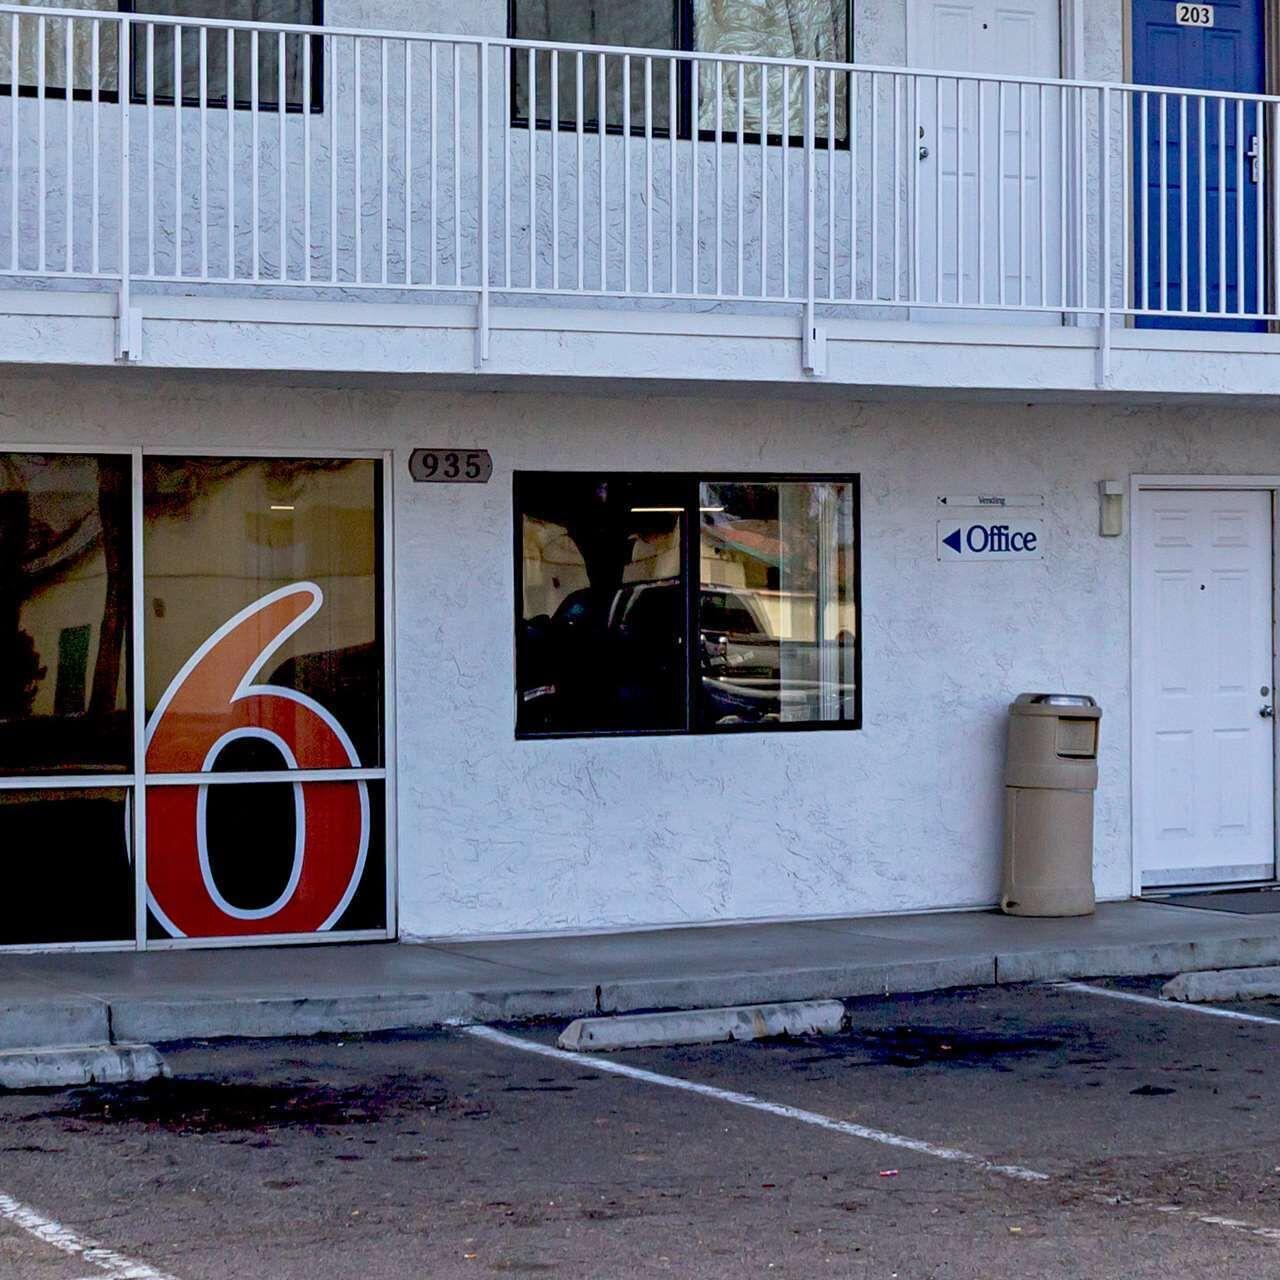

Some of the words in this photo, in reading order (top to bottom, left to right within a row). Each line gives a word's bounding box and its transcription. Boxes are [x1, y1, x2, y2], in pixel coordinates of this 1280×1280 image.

[1180, 6, 1210, 24] 203
[422, 453, 481, 479] 935
[966, 524, 1038, 553] Office
[124, 581, 370, 938] 6
